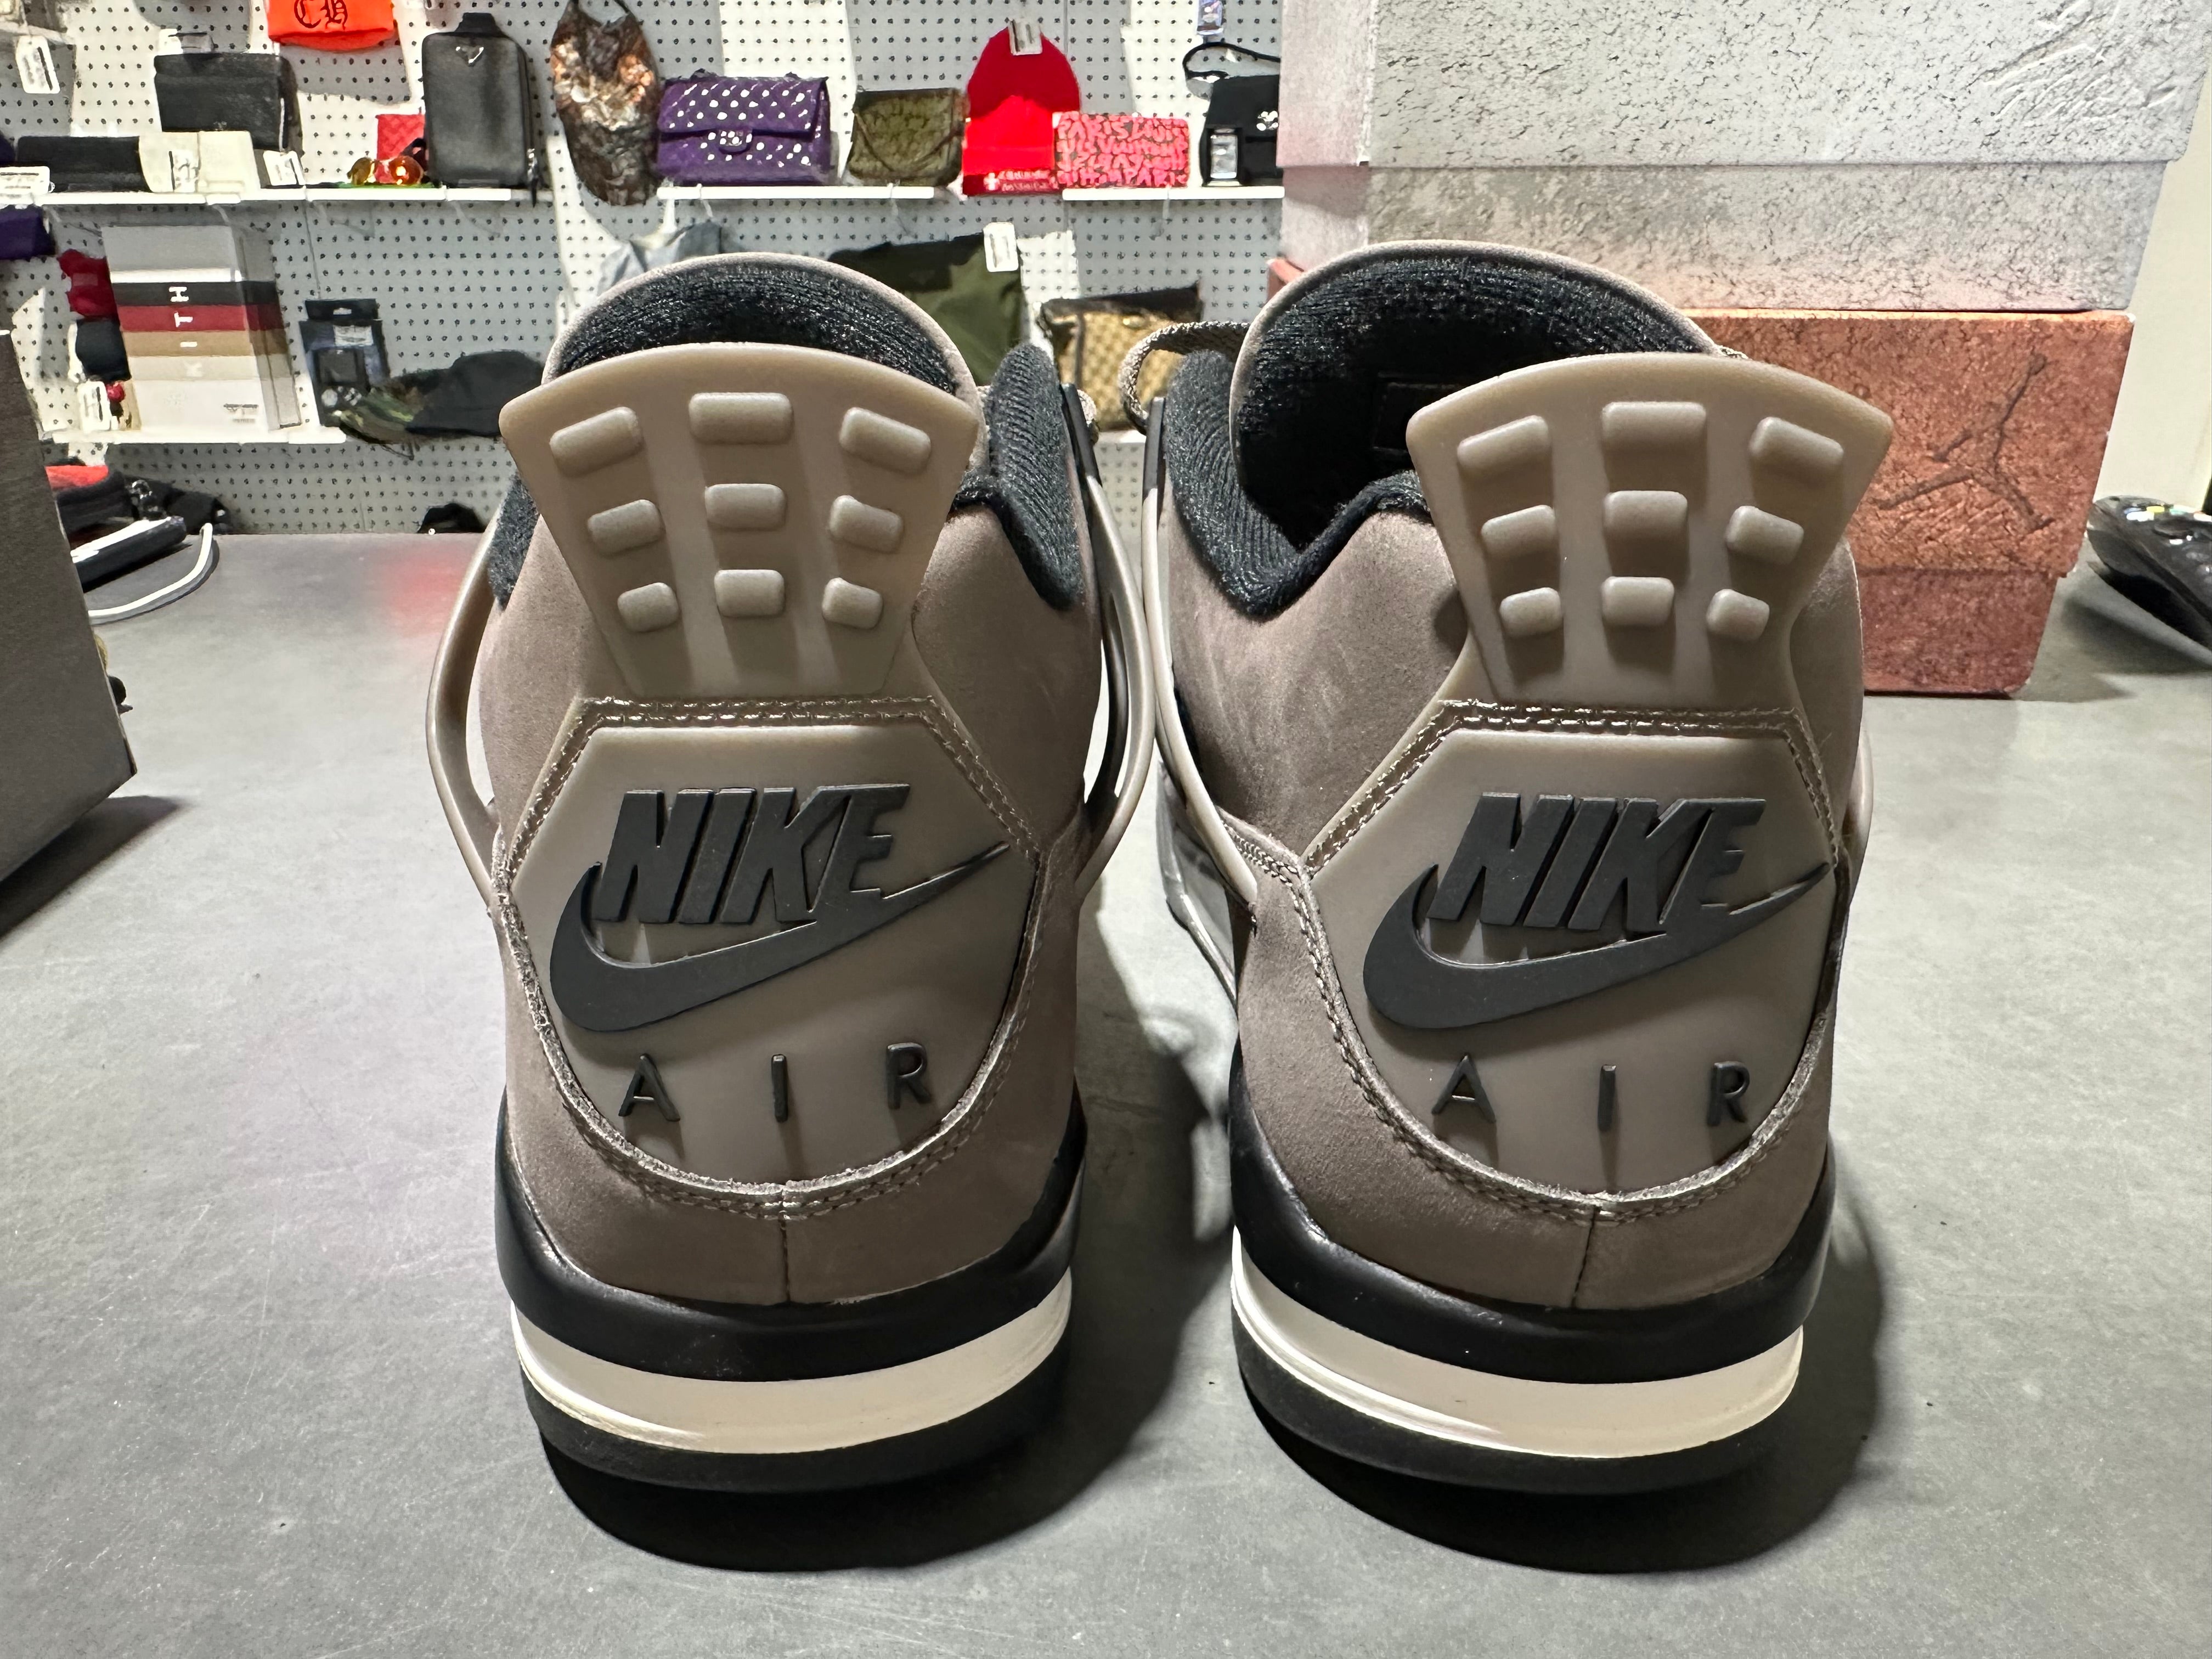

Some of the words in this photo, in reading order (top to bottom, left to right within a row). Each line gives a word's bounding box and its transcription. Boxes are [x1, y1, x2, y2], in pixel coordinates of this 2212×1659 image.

[591, 783, 911, 924] NIKE
[1426, 791, 1767, 932] NIKE
[618, 1042, 934, 1123] AIR
[1431, 1053, 1751, 1132] AIR
